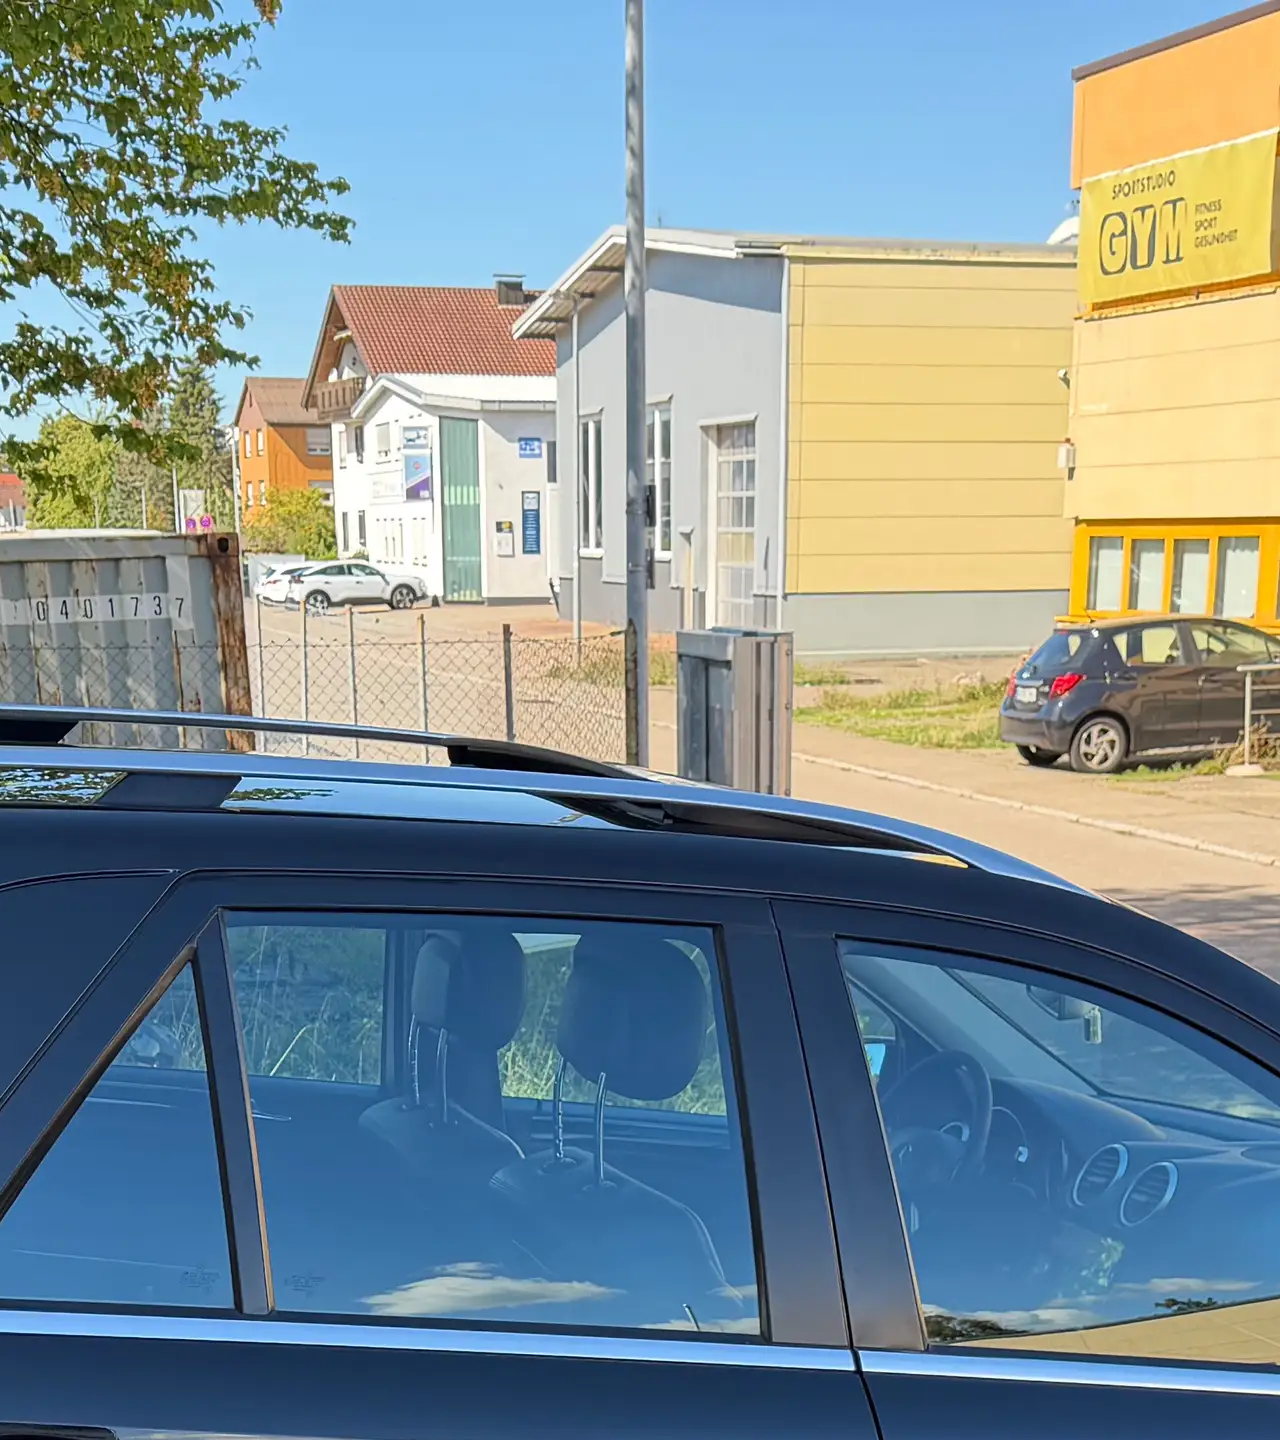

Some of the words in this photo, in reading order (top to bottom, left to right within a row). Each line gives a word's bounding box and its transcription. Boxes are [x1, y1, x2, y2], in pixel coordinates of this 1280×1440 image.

[1112, 170, 1176, 200] SPORTSTUDIO
[1194, 199, 1222, 215] FITNESS
[1194, 217, 1217, 232] SPORT
[1099, 197, 1187, 276] GYM
[1194, 229, 1238, 248] GESUNDHEIT
